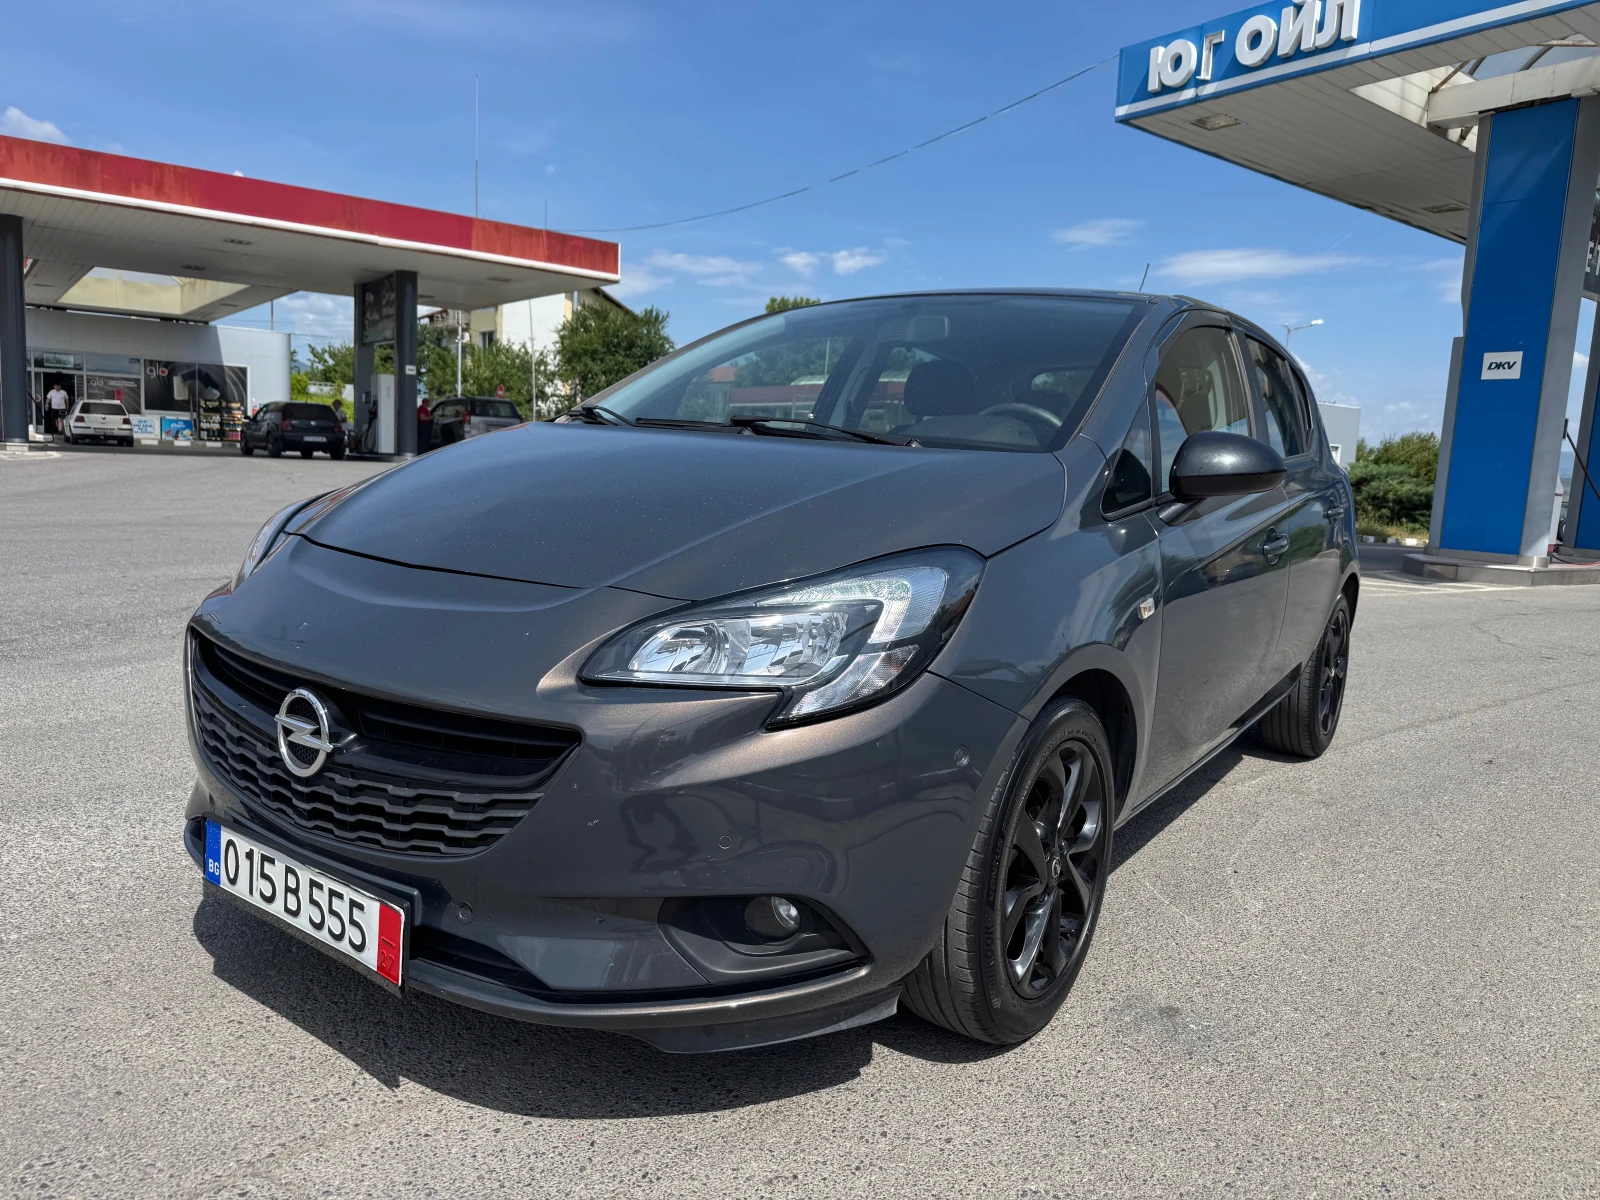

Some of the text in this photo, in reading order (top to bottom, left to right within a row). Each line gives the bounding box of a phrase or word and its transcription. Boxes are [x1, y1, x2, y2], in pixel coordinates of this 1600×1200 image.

[1148, 0, 1361, 93] ЮГ ОЙЛ
[147, 362, 168, 378] glo
[1486, 360, 1518, 370] DKV
[91, 377, 104, 387] glo
[208, 858, 220, 876] BG
[380, 950, 395, 972] 27
